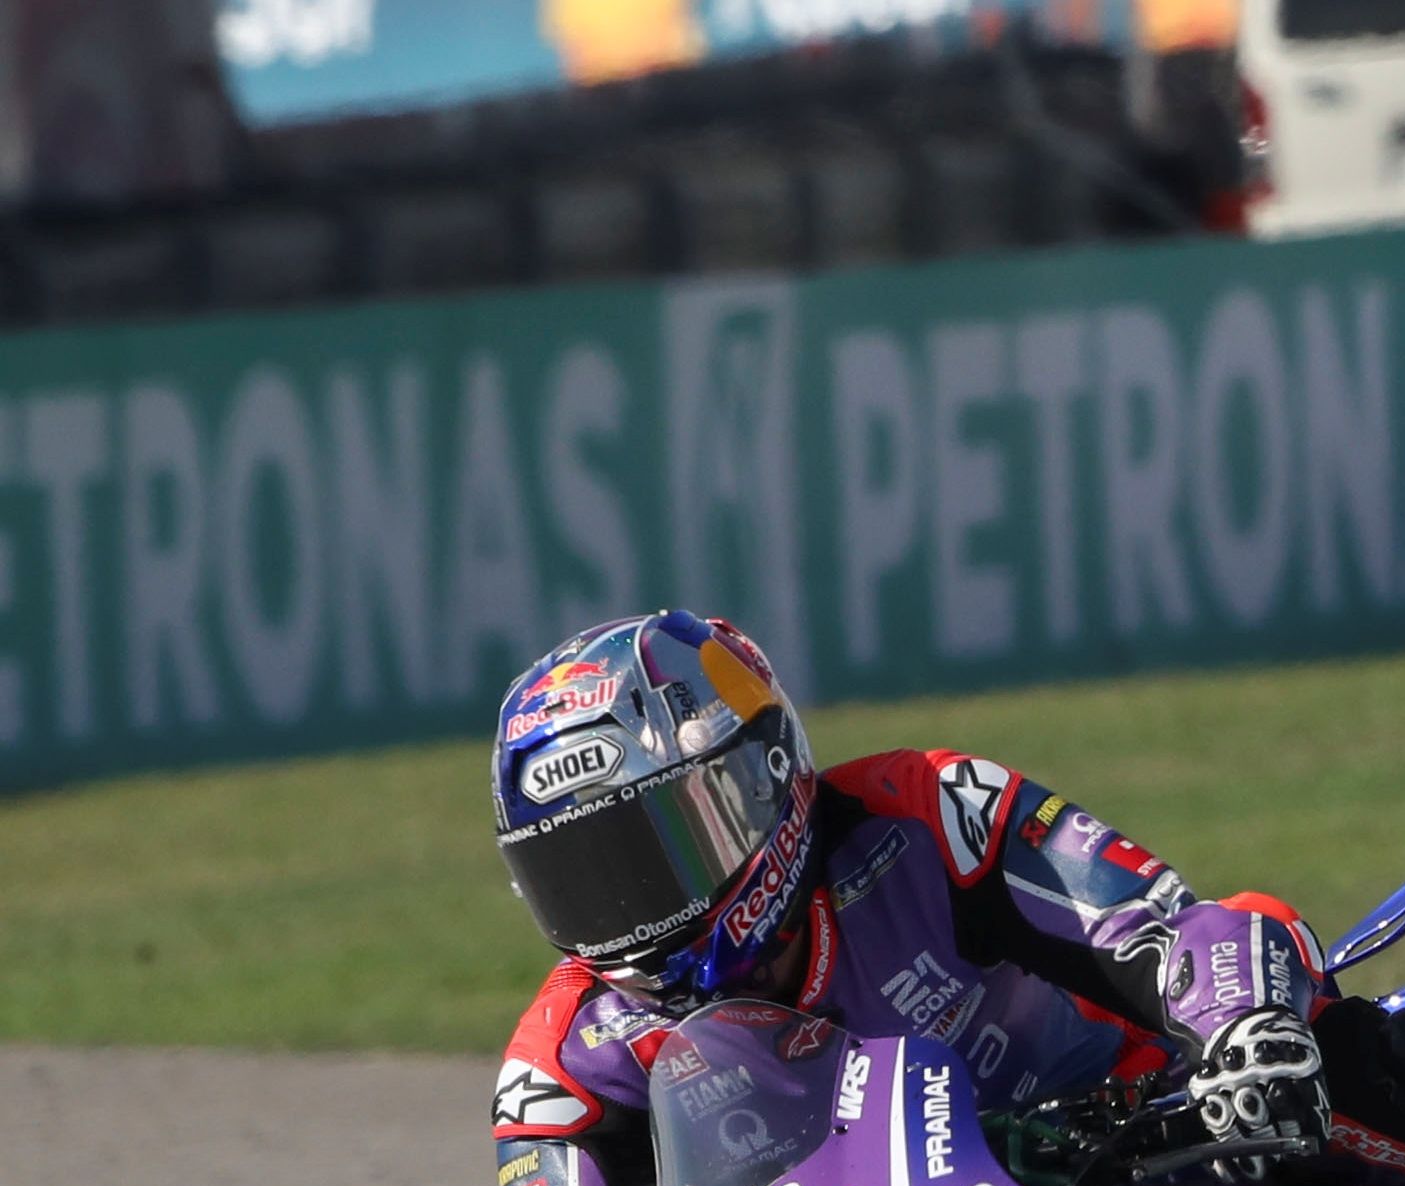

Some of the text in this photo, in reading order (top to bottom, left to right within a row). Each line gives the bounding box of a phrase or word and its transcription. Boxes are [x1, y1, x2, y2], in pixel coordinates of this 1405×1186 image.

[0, 342, 638, 740] TRONAS
[506, 677, 618, 743] Red Bull
[671, 681, 698, 721] Beta
[532, 744, 607, 793] SHOEI
[637, 758, 703, 794] PRAMAC
[552, 795, 617, 828] PRAMAC
[723, 851, 789, 948] Red
[752, 827, 813, 943] PRAMAC
[575, 896, 712, 959] Borusan Otomotiv
[879, 950, 955, 1013] 21
[1209, 940, 1240, 1008] prima
[836, 1050, 872, 1121] WRS
[924, 1065, 954, 1180] PRAMAC
